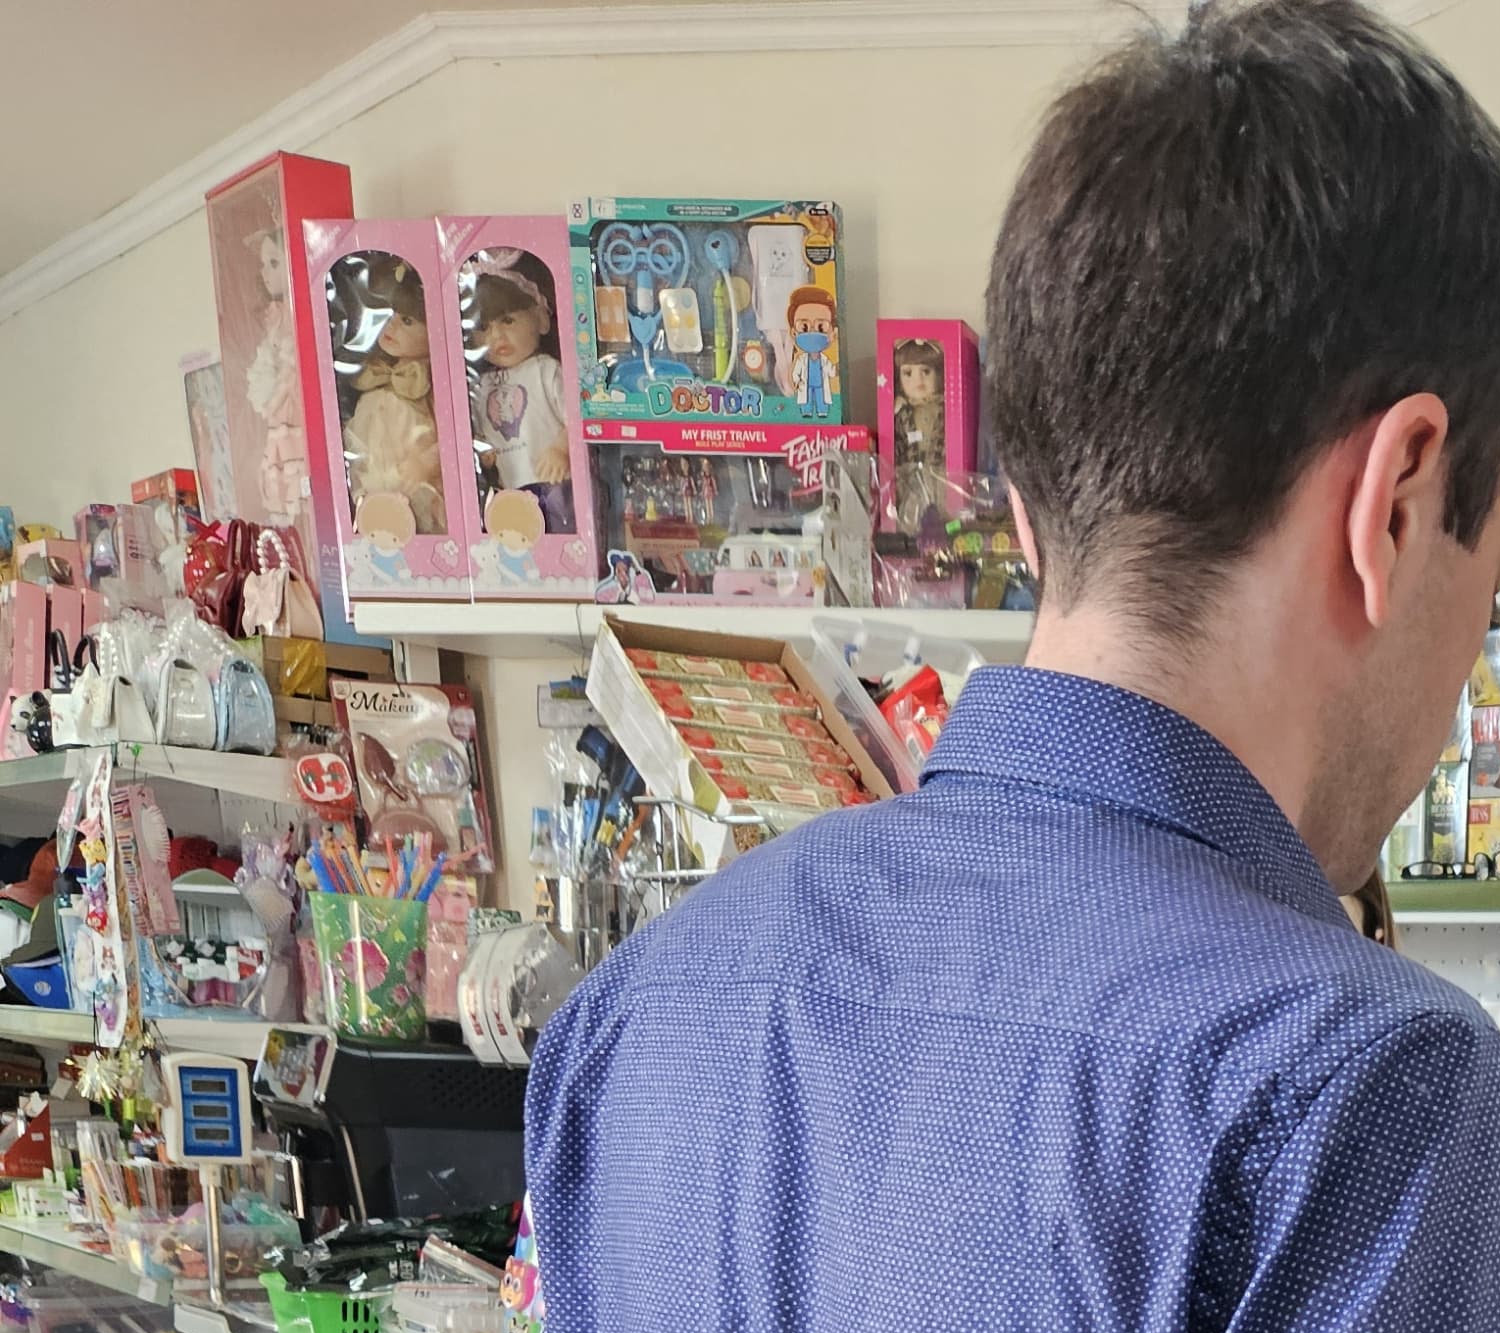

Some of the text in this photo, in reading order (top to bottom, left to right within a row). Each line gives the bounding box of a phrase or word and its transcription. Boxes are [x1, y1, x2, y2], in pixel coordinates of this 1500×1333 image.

[648, 383, 762, 416] DOCTOR
[681, 429, 767, 443] MY FRIST TRAVEL
